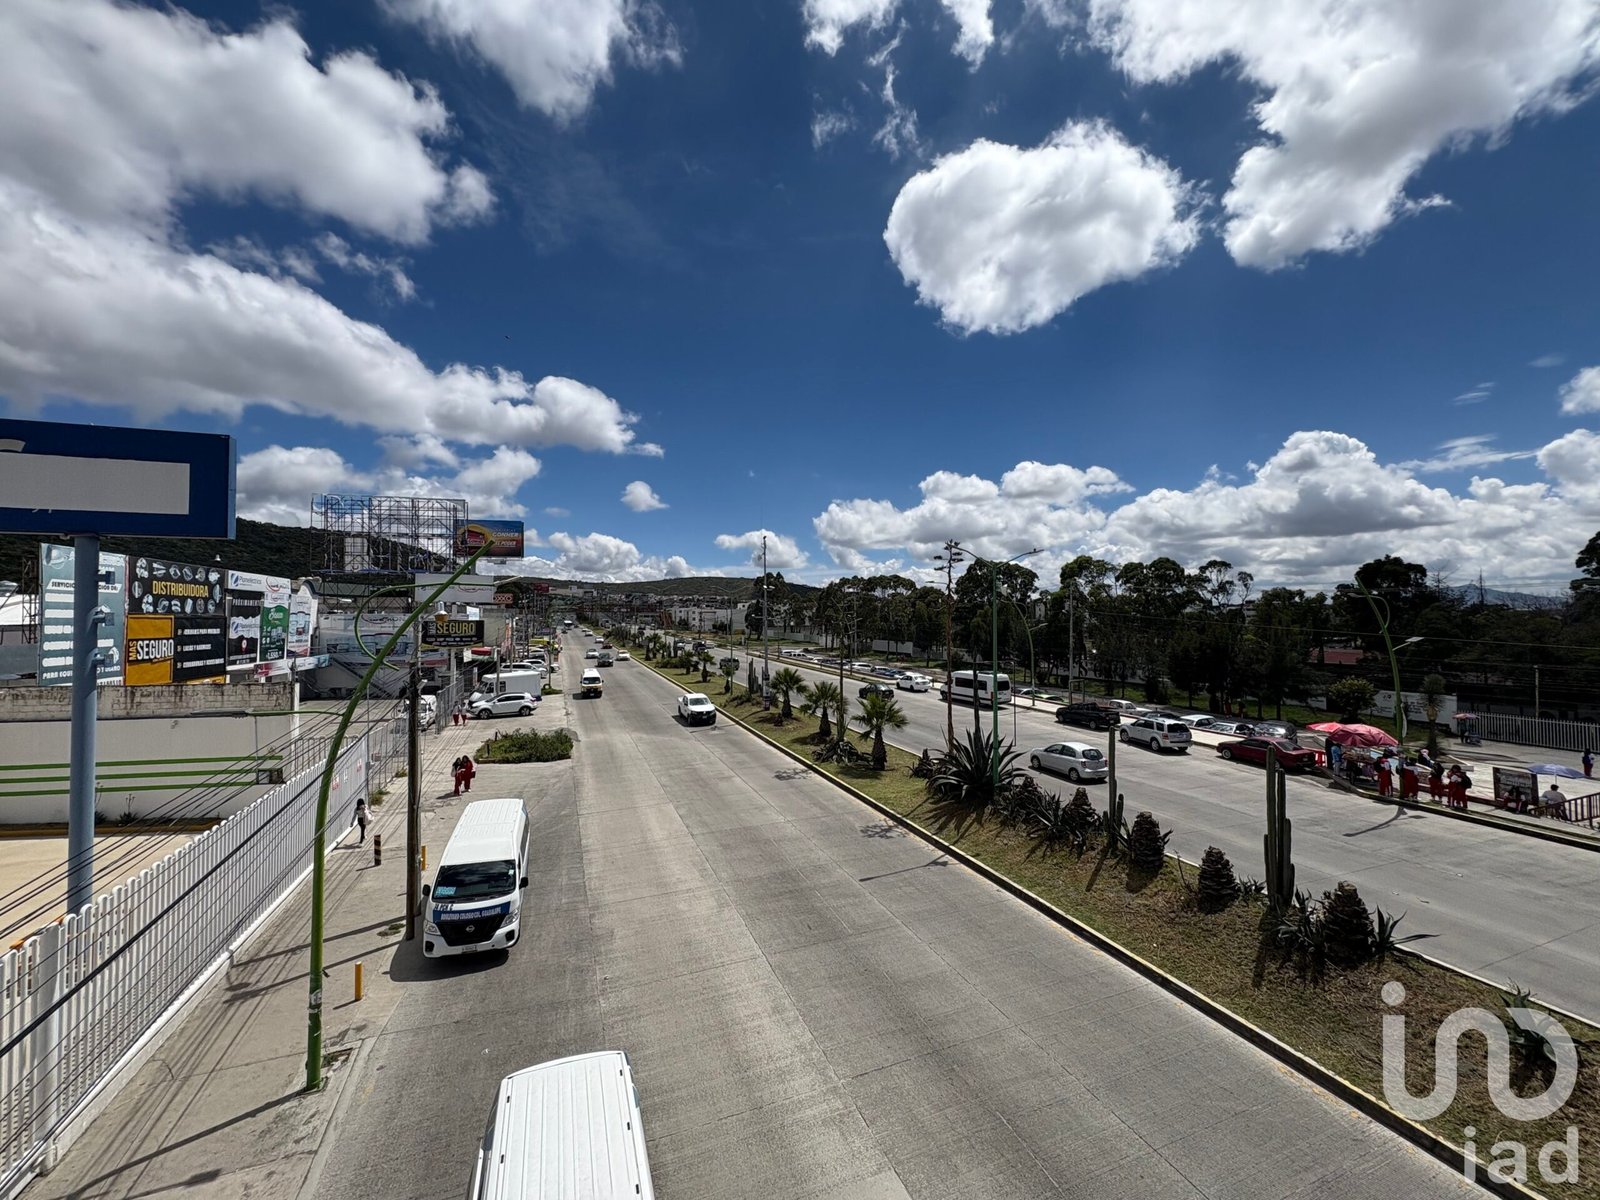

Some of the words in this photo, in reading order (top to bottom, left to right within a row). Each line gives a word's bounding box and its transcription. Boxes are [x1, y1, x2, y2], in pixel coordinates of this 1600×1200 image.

[152, 580, 209, 598] DISTRIBUIDORA
[494, 594, 514, 603] OXXO
[437, 622, 475, 634] SEGURO
[129, 641, 137, 660] MAS
[137, 639, 174, 660] SEGURO
